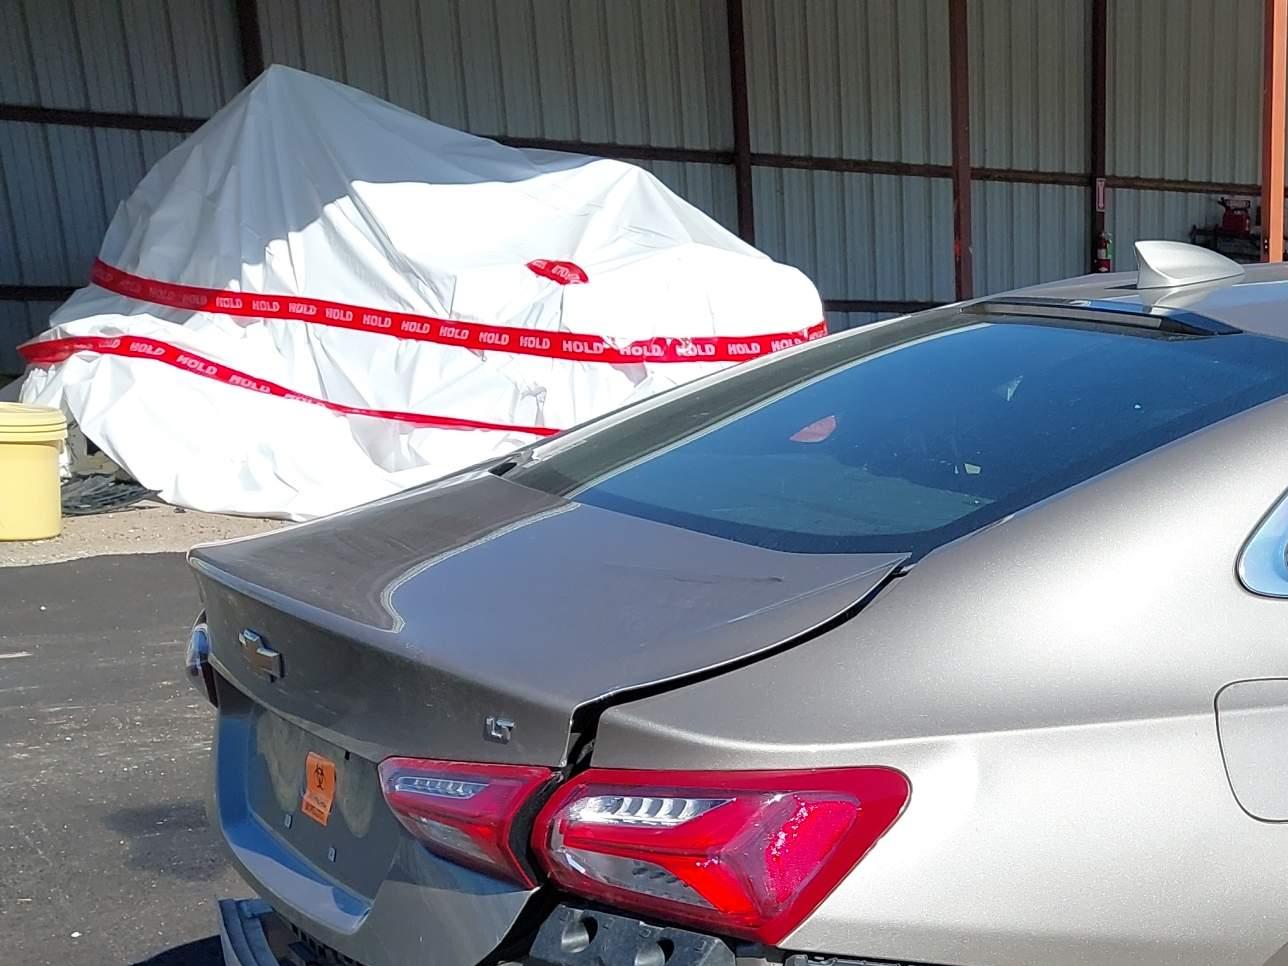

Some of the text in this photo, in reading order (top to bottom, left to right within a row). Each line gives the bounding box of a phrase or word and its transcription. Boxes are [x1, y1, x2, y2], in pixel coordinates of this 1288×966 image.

[216, 297, 243, 309] HOLD
[252, 300, 280, 312] HOLD
[288, 303, 317, 315] HOLD
[325, 307, 353, 322] HOLD
[362, 314, 392, 328] HOLD
[401, 320, 431, 334] HOLD
[439, 326, 470, 340] HOLD
[479, 332, 510, 345] HOLD
[520, 336, 551, 349] HOLD
[562, 340, 604, 354] HOLD
[728, 343, 760, 354] HOLD
[130, 342, 166, 356] HOLD
[176, 354, 218, 376] HOLD
[486, 717, 514, 740] LT
